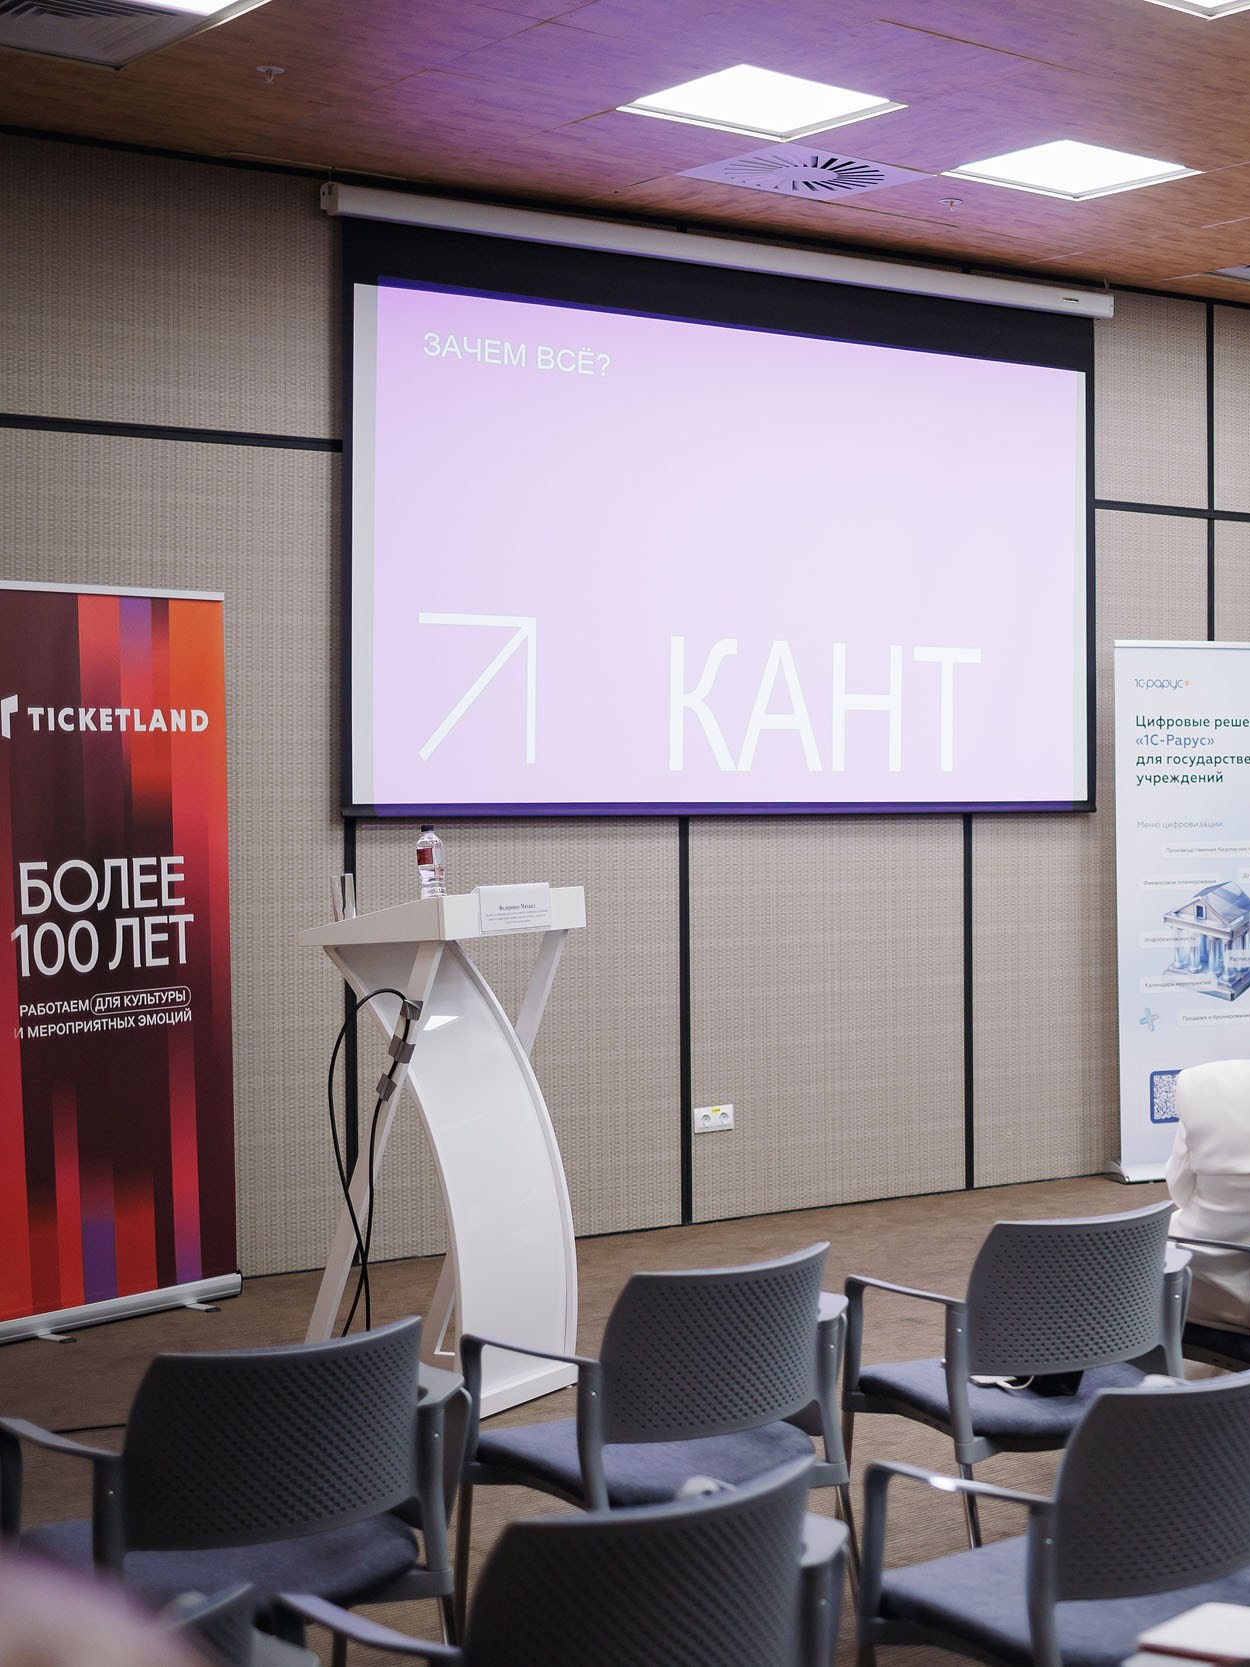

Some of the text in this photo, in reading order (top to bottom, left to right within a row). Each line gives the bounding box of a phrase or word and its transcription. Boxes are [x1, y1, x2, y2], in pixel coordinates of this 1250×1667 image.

[423, 331, 611, 376] ЗАЧЕМ ВСЁ?
[668, 635, 982, 772] КАНТ
[27, 706, 209, 732] TICKETLAND
[1135, 715, 1211, 729] Цифровые
[1135, 734, 1215, 748] «1С-Рарус»
[1136, 754, 1163, 765] для
[1136, 771, 1224, 786] учреждений
[1136, 820, 1161, 829] Меню
[19, 855, 186, 916] БОЛЕЕ
[10, 914, 195, 978] 100 ЛЕТ
[19, 990, 187, 1017] РАБОТАЕМ ДЛЯ КУЛЬТУРЫ
[14, 1007, 192, 1040] И МЕРОПРИЯТНЫХ ЭМОЦИЙ
